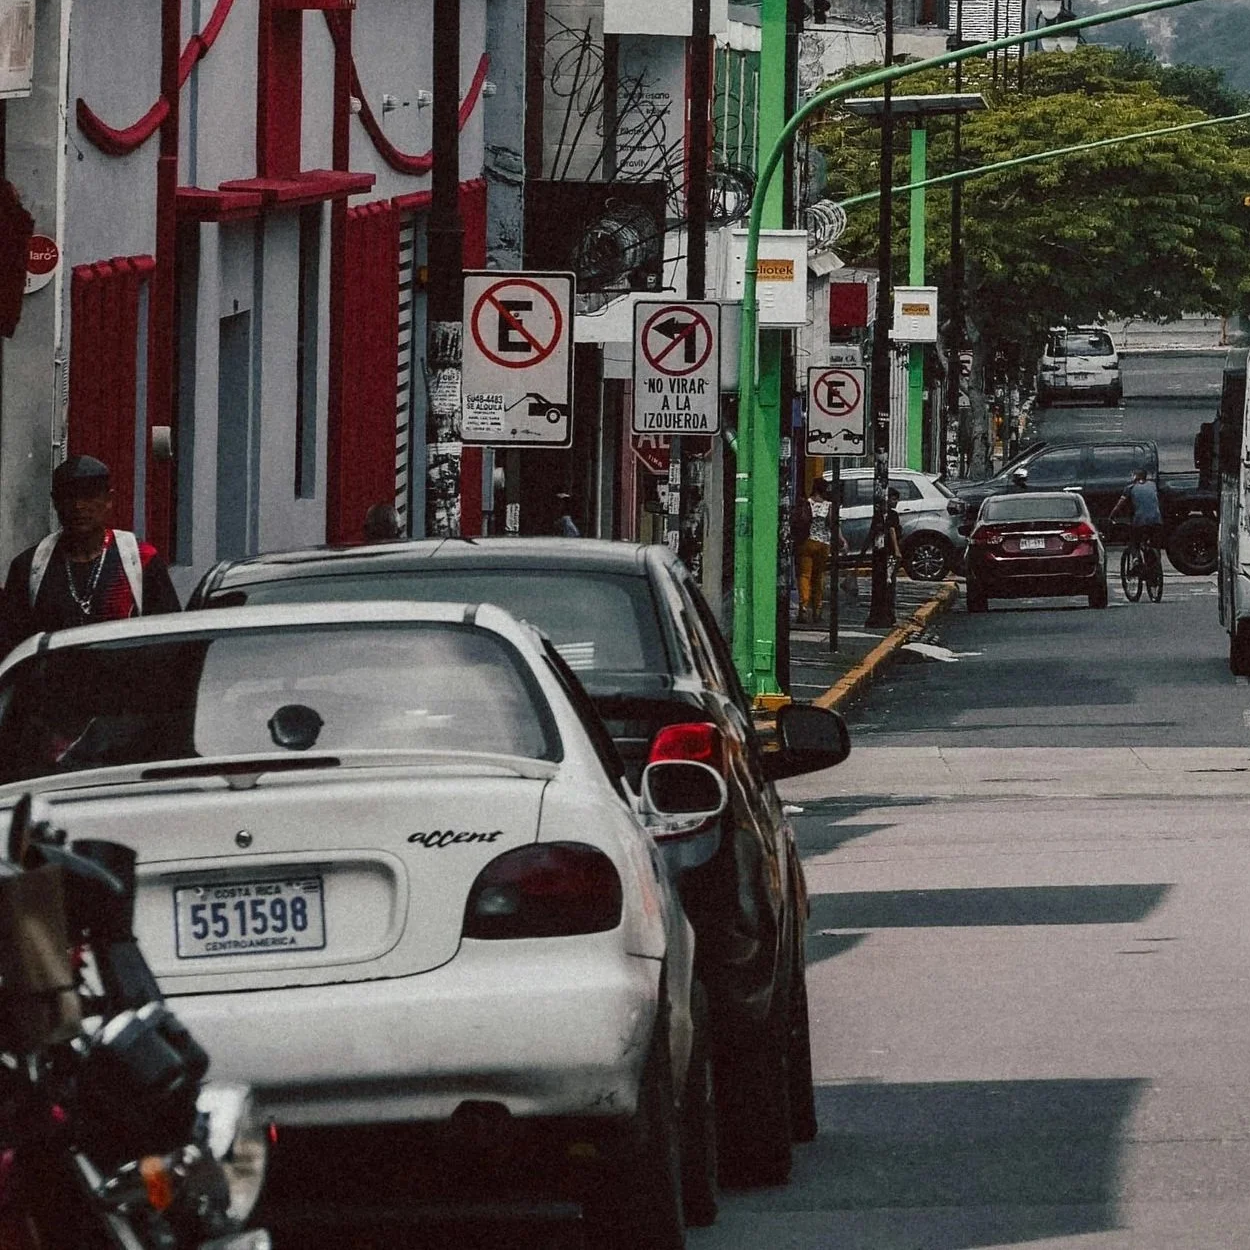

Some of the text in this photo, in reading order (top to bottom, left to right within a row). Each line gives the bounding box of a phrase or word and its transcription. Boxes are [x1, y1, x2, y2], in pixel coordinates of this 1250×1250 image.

[29, 251, 52, 261] laro
[648, 377, 705, 394] NO VIRAR
[476, 403, 503, 411] ALQUILA
[661, 394, 691, 411] A LA
[407, 829, 504, 848] accent
[215, 884, 282, 899] COSTA RICA
[190, 895, 308, 940] 551598
[204, 935, 297, 952] CENTROAMERICA
